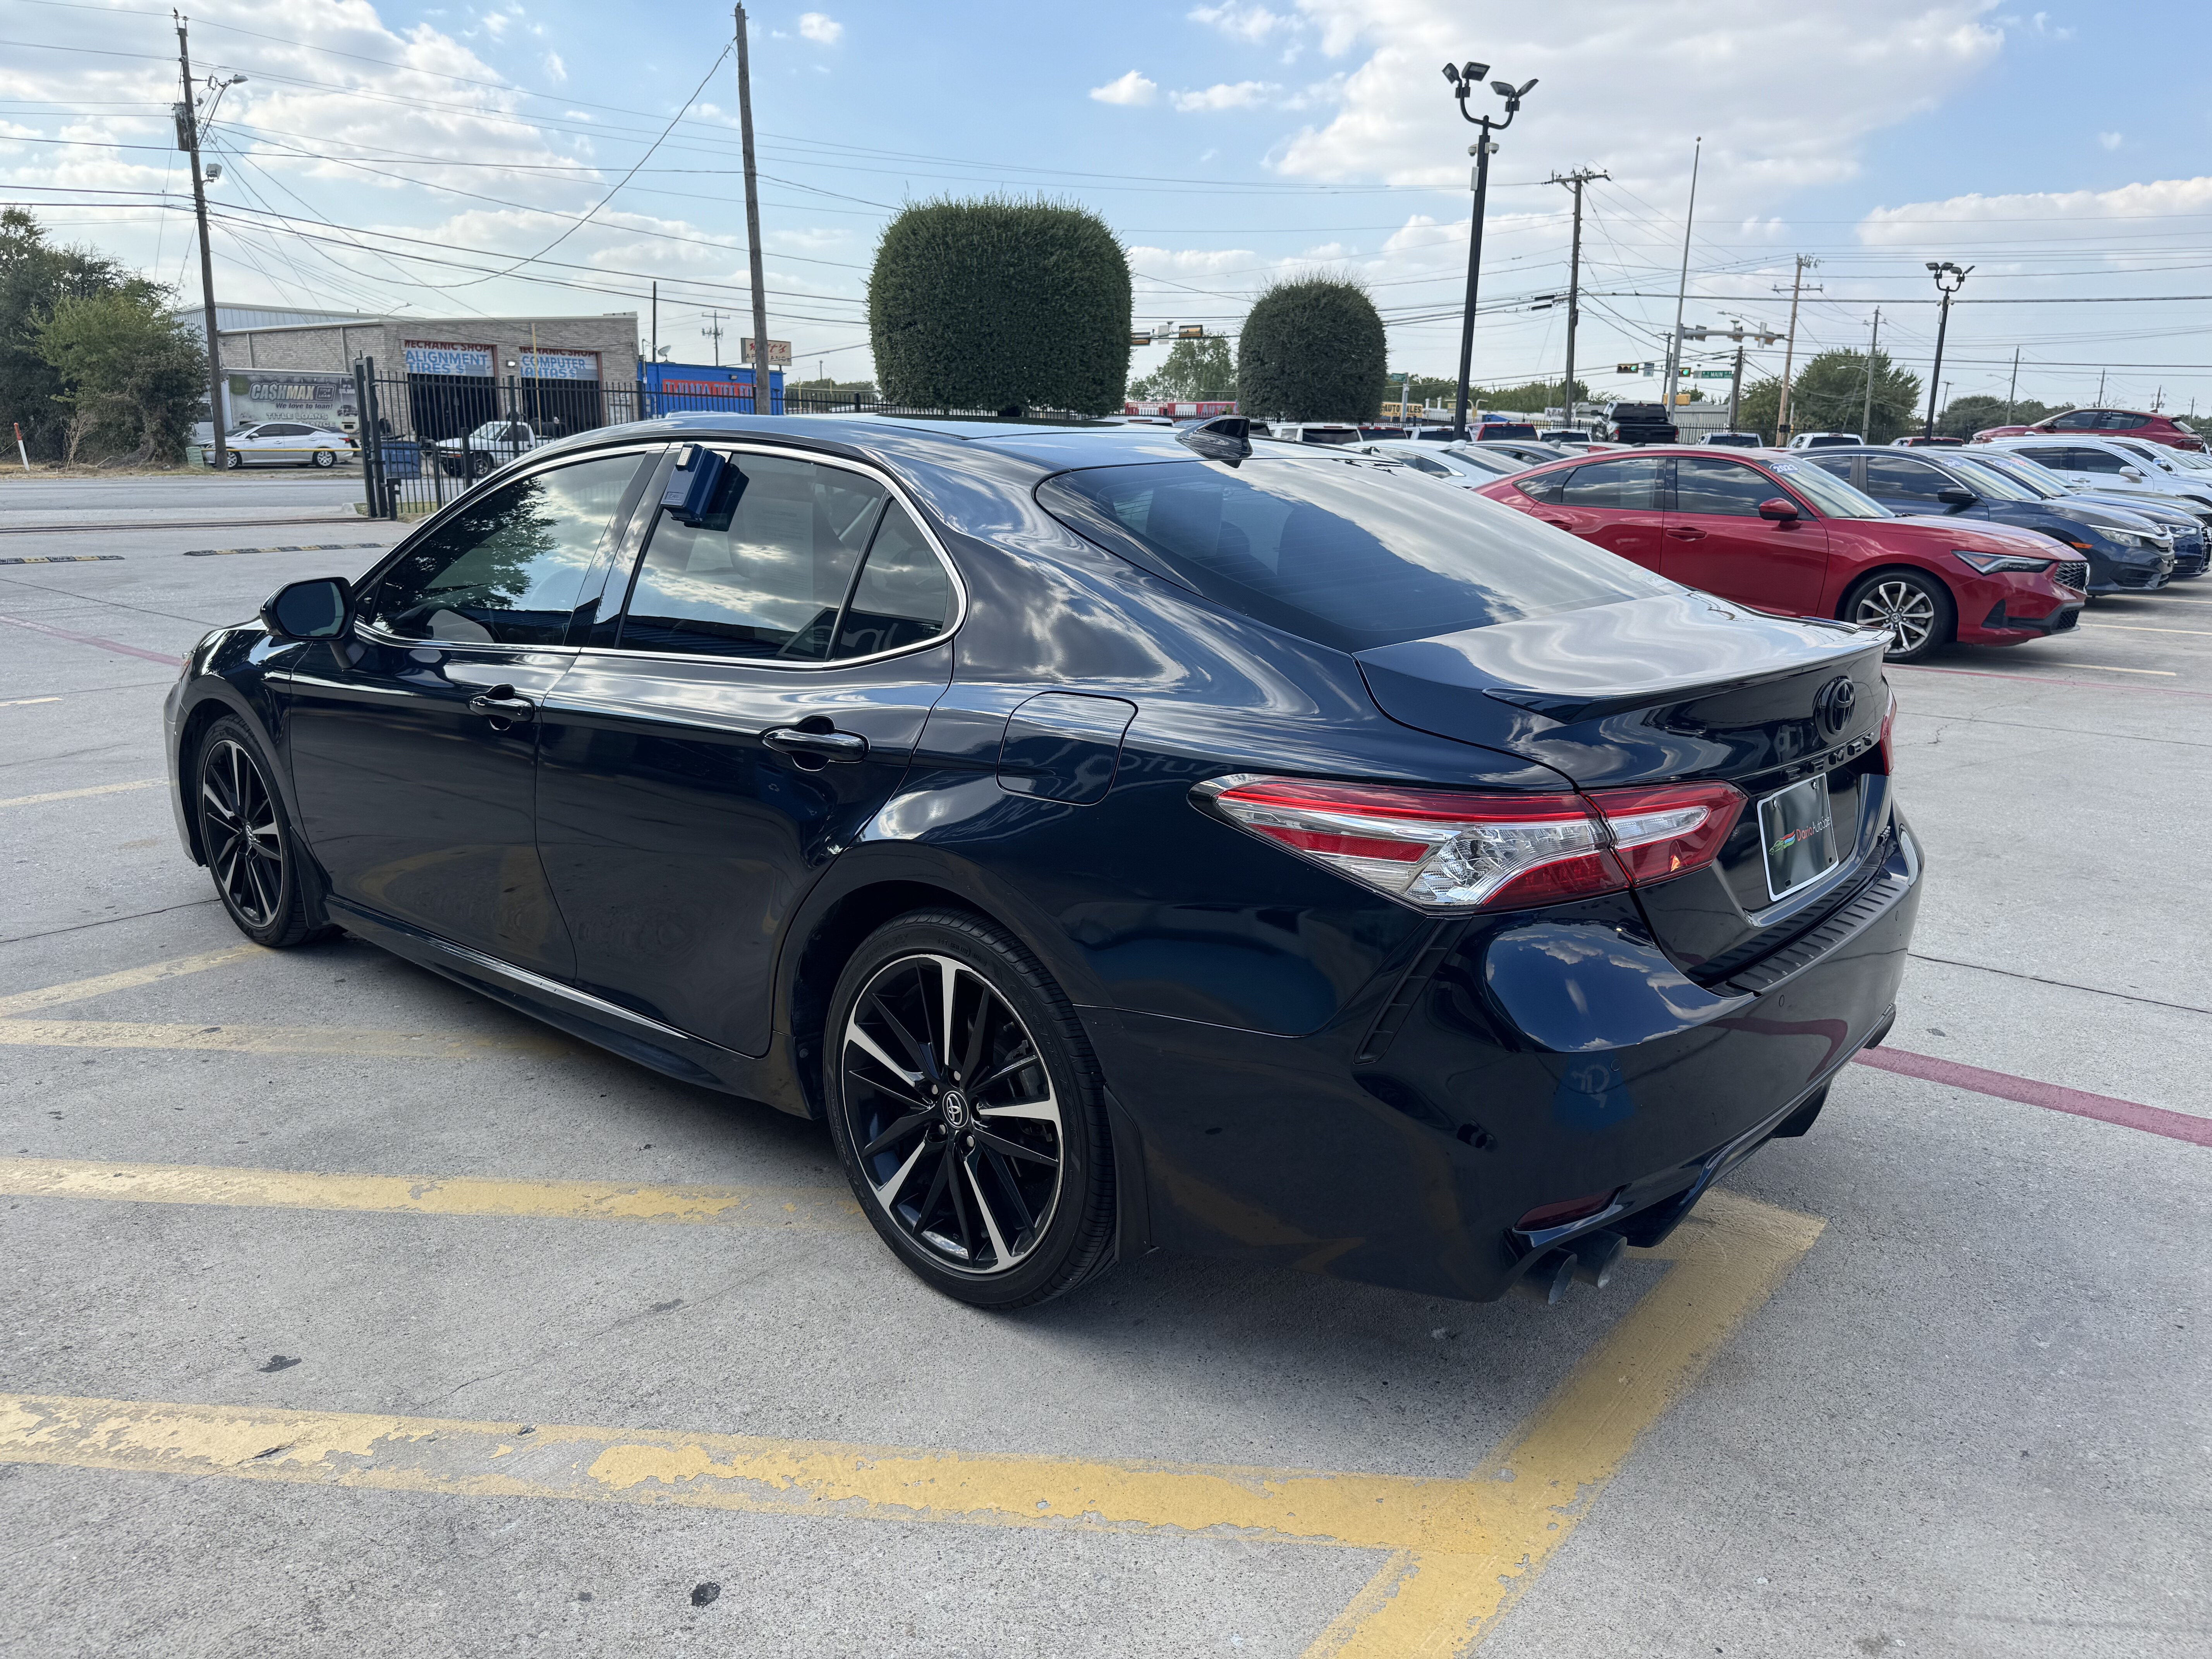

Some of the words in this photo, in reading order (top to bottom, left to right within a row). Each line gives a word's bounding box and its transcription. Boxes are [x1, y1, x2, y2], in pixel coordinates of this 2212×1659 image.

[460, 344, 490, 352] SHOP
[406, 350, 488, 366] ALIGNMENT
[522, 356, 586, 369] COMPUTER
[407, 362, 451, 374] TIRES
[456, 364, 464, 374] $
[569, 369, 576, 378] $
[251, 382, 315, 401] CA$HMAX
[1385, 404, 1400, 413] AUTO
[1773, 464, 1799, 472] 2023
[1780, 732, 1874, 783] CAMRY
[1009, 982, 1079, 1140] GOODYEAR
